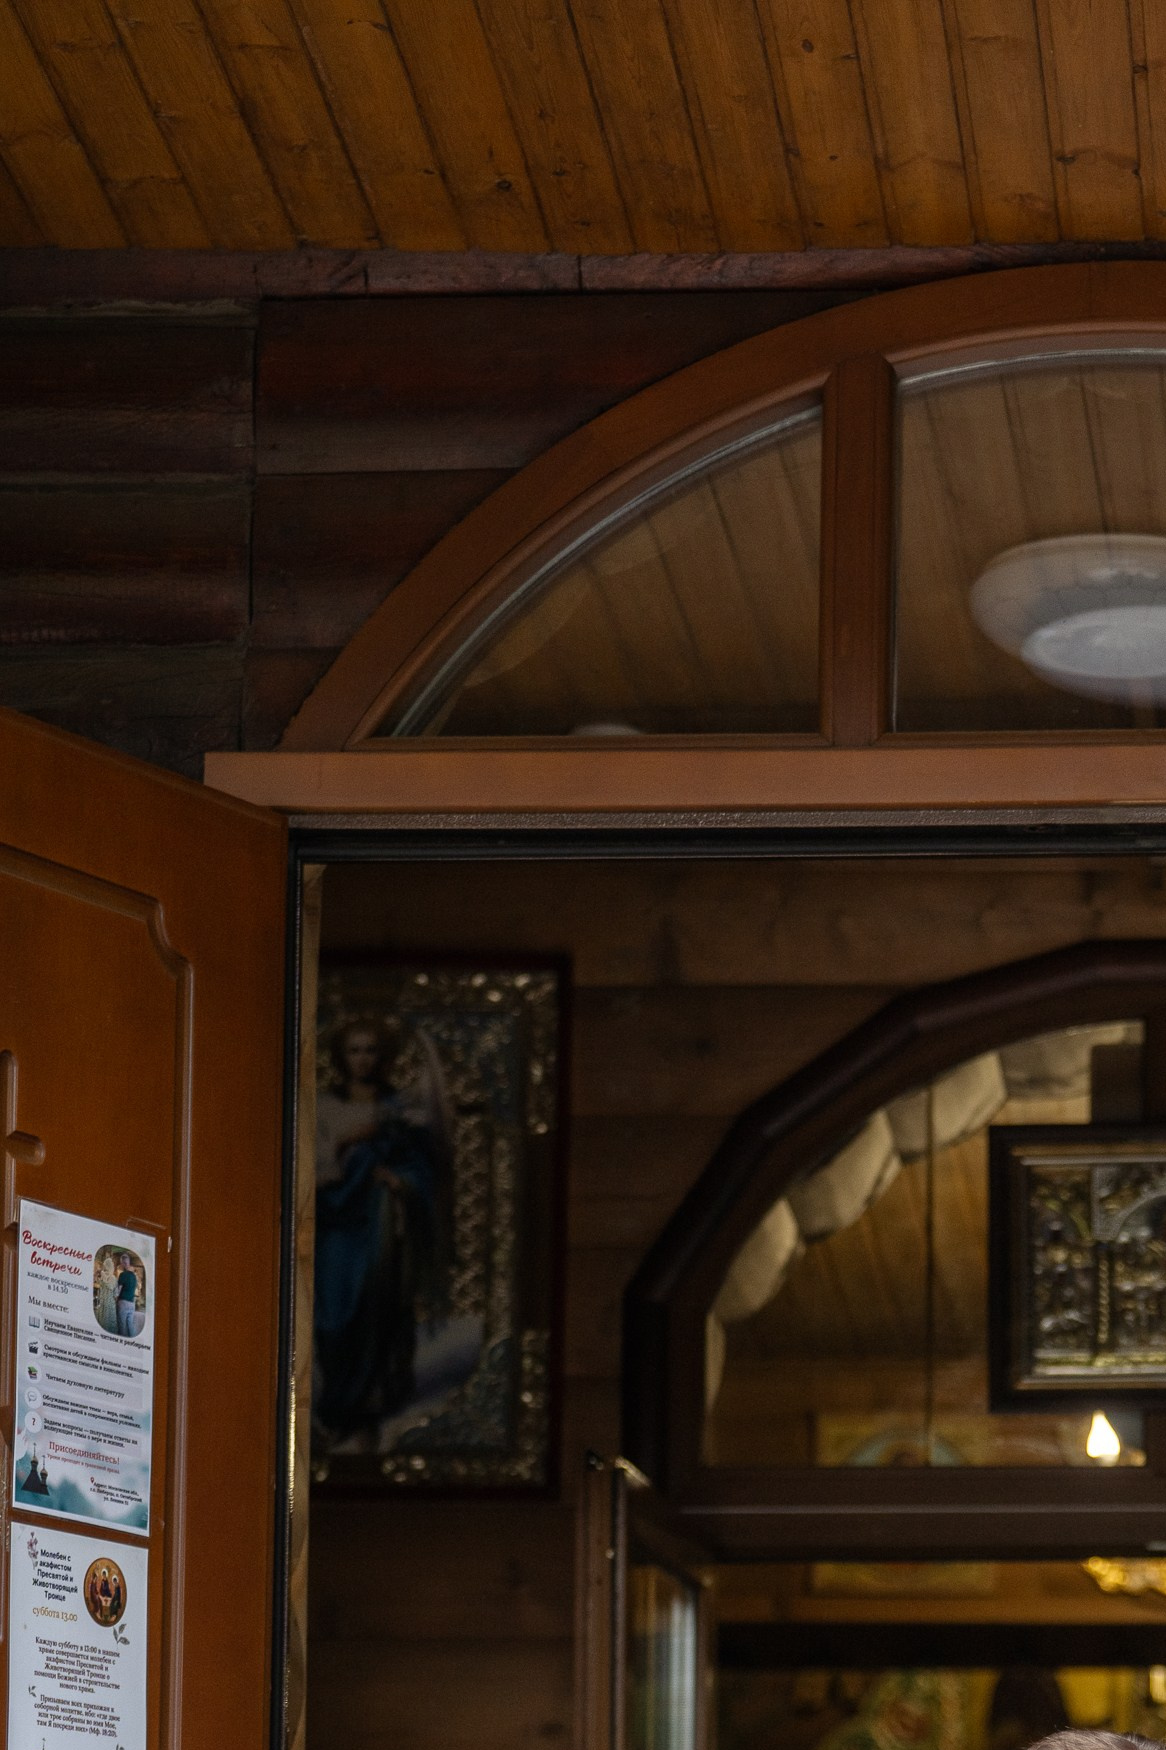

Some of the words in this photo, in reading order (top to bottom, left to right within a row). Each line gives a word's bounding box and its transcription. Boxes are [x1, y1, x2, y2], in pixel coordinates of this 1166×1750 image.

[22, 1230, 92, 1261] Воскресные
[31, 1251, 82, 1276] встречи
[27, 1272, 49, 1282] каждое
[28, 1296, 41, 1306] Мы
[46, 1373, 66, 1384] Читаем
[66, 1379, 93, 1390] духовную
[94, 1387, 125, 1399] литературу
[49, 1441, 120, 1465] Присоединяйтесь!
[40, 1549, 66, 1561] Молебен
[39, 1561, 72, 1572] акафистом
[37, 1569, 69, 1582] Пресвятой
[32, 1578, 78, 1593] Животворящей
[45, 1590, 66, 1602] Троице
[33, 1607, 60, 1619] суббота
[36, 1637, 57, 1647] Каждую
[58, 1641, 79, 1652] субботу
[102, 1650, 120, 1658] нашем
[46, 1656, 76, 1665] акафистом
[76, 1661, 104, 1671] Пресвятой
[56, 1650, 89, 1660] совершается
[90, 1656, 111, 1664] молебен
[45, 1663, 86, 1676] Животворящей
[87, 1670, 106, 1680] Троице
[34, 1670, 57, 1679] помощи
[83, 1678, 120, 1690] строительстве
[34, 1702, 60, 1712] соборной
[41, 1694, 70, 1705] Призываем
[84, 1703, 110, 1712] прихожан
[53, 1722, 74, 1731] посреди
[63, 1715, 85, 1724] собраны
